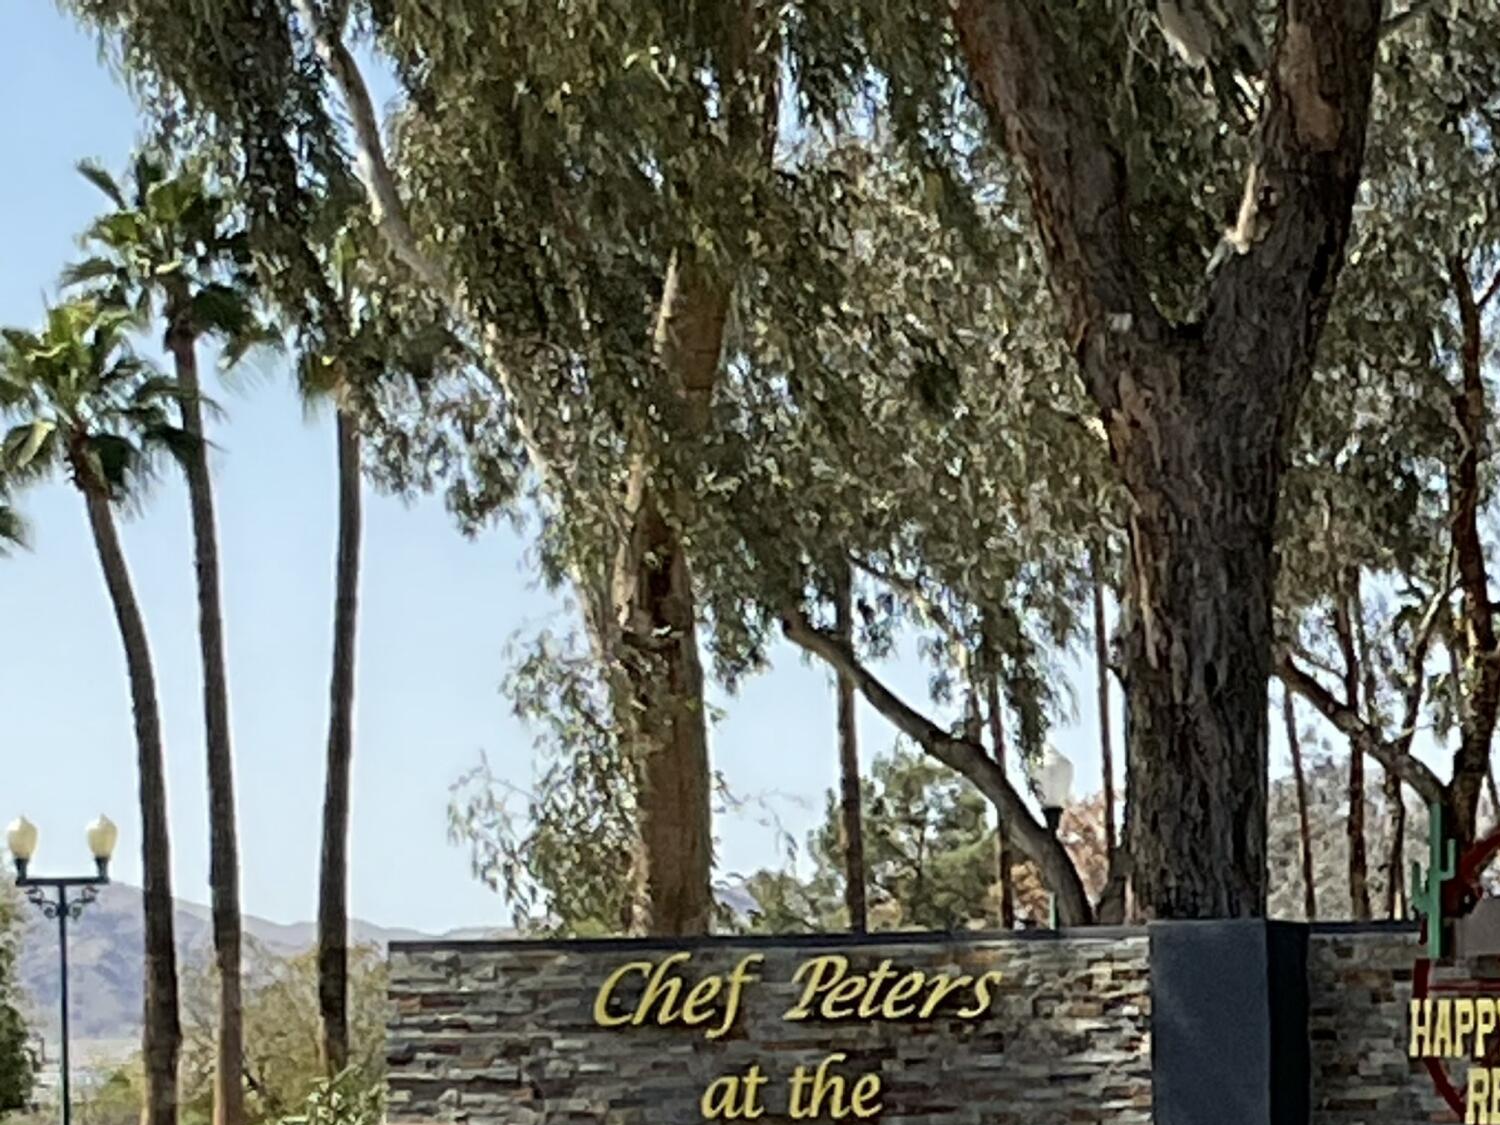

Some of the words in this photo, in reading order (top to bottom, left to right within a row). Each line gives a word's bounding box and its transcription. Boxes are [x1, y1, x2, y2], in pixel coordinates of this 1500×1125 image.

[592, 951, 764, 1039] Chef
[783, 954, 1003, 1022] Peters
[701, 1067, 763, 1119] at
[789, 1052, 883, 1119] the
